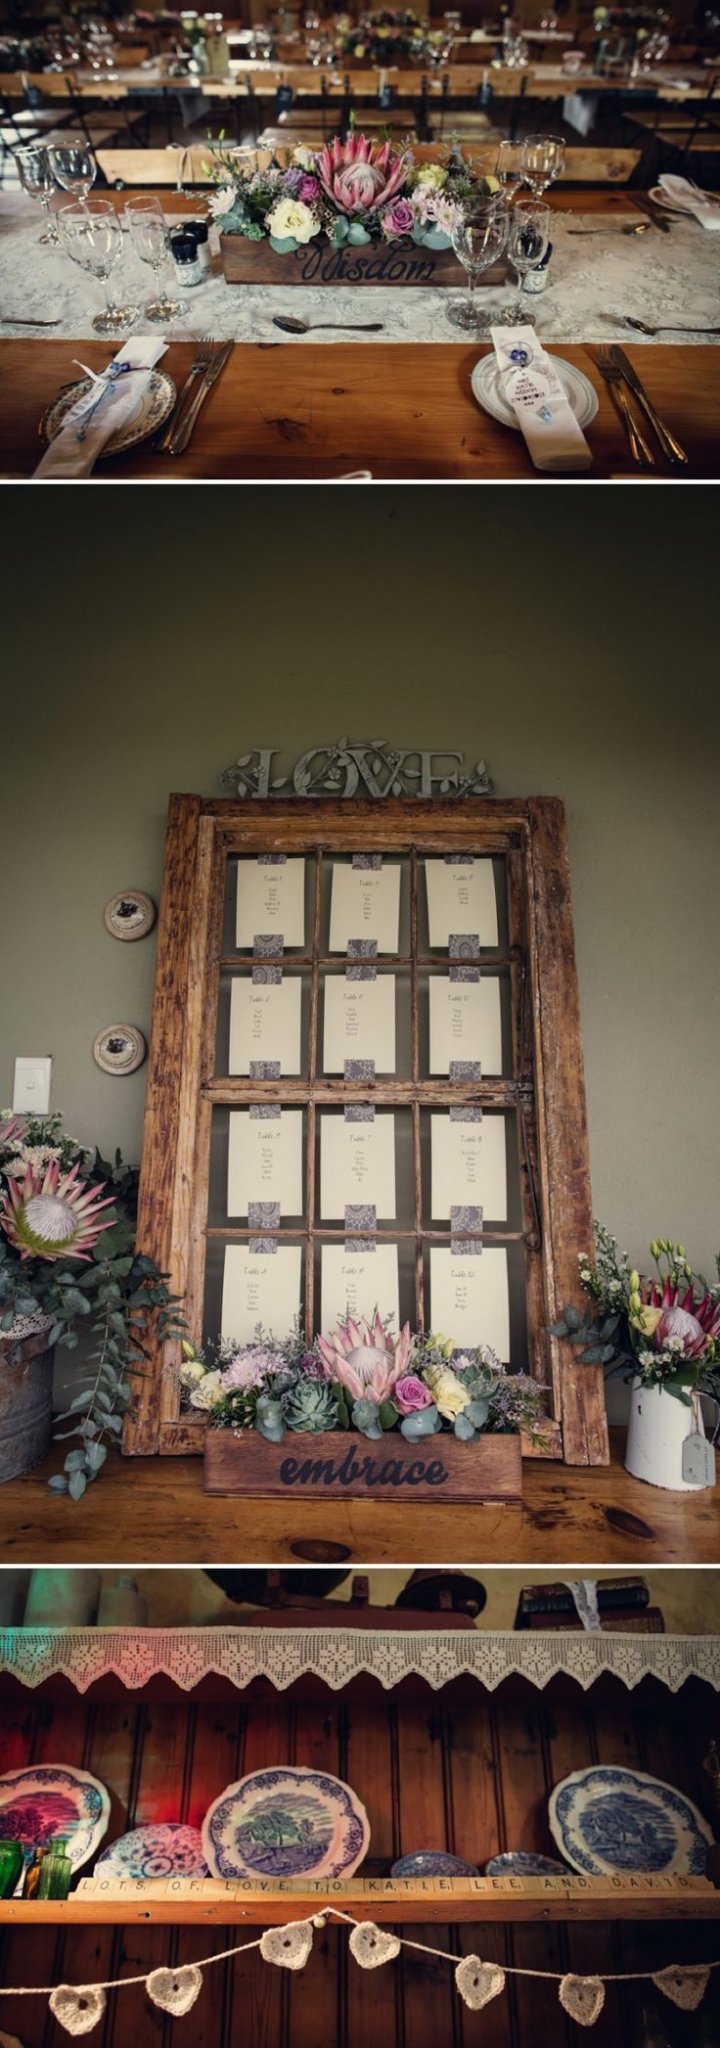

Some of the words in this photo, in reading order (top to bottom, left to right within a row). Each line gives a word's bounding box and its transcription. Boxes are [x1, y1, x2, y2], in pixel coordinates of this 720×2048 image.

[294, 239, 437, 281] Wisdom
[247, 741, 466, 798] LOVE
[279, 1444, 449, 1486] embrace
[82, 1880, 146, 1891] LOTS
[171, 1880, 200, 1891] OF
[224, 1880, 289, 1891] LOVE
[313, 1881, 344, 1891] TO
[368, 1880, 451, 1891] KATIE
[474, 1879, 522, 1889] LEE
[544, 1878, 592, 1889] AND
